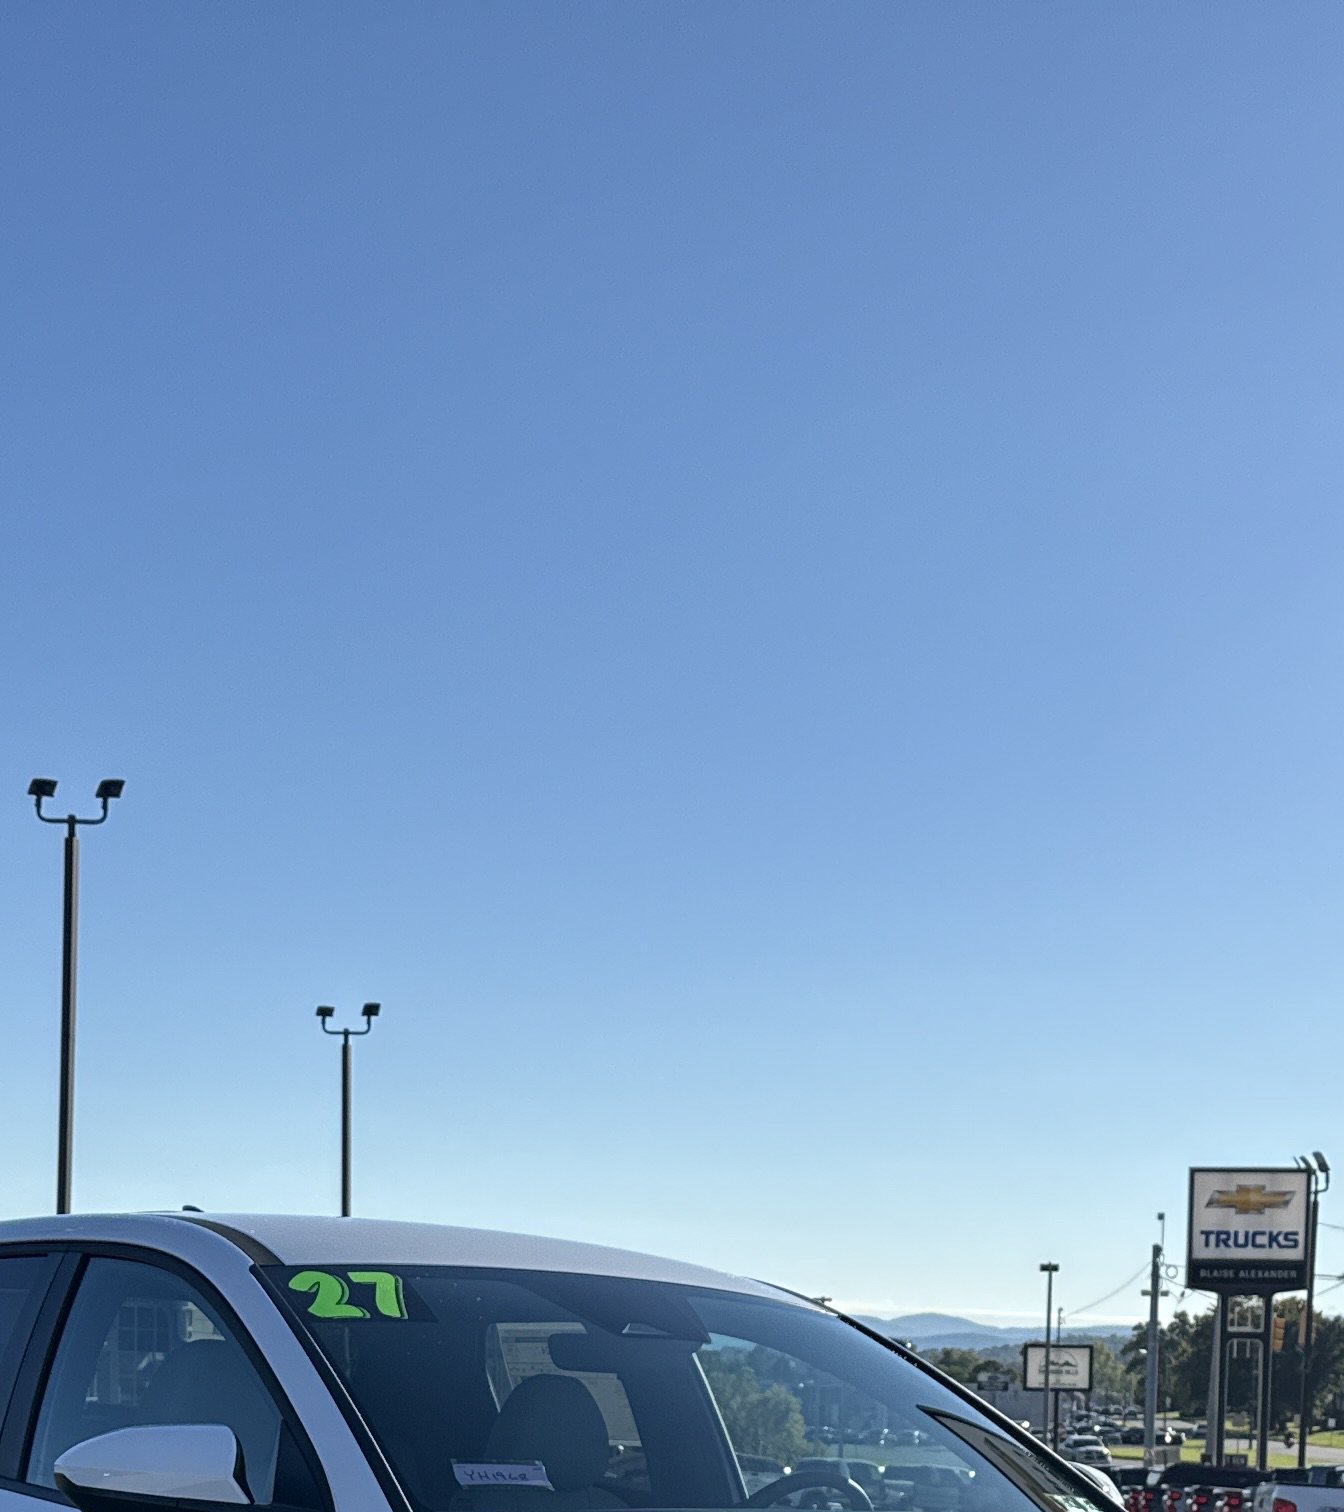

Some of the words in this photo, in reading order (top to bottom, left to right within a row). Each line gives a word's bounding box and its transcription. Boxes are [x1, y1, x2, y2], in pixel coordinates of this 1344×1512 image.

[1200, 1230, 1299, 1249] TRUCKS
[1199, 1268, 1235, 1279] BLAISE
[1238, 1268, 1297, 1279] ALEXANDER
[288, 1270, 408, 1320] 27
